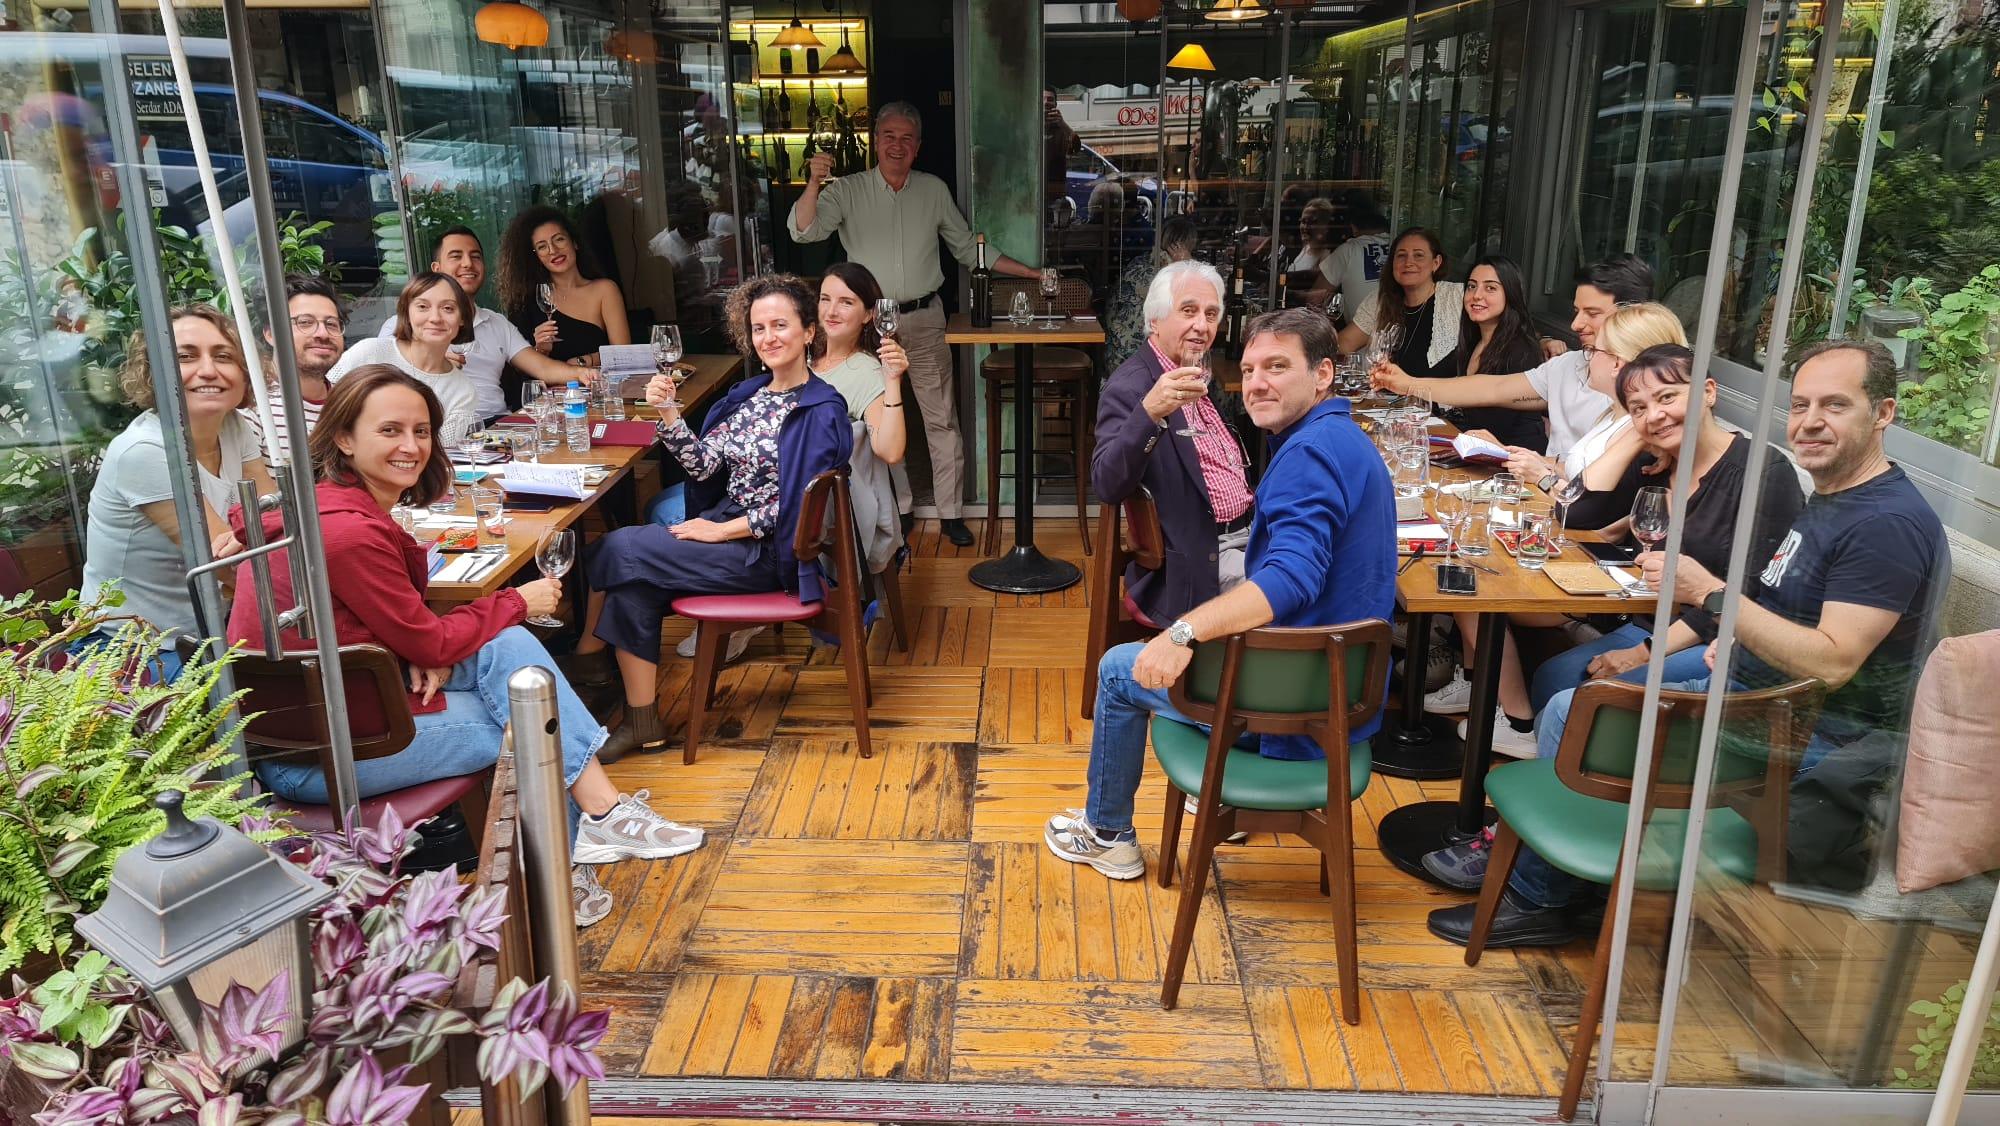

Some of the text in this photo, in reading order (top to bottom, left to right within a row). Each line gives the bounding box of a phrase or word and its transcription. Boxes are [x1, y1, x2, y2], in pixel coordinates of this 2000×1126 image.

[132, 81, 181, 96] ZANES
[135, 100, 185, 114] Serdar ADA
[621, 820, 644, 836] N
[1071, 834, 1091, 853] N
